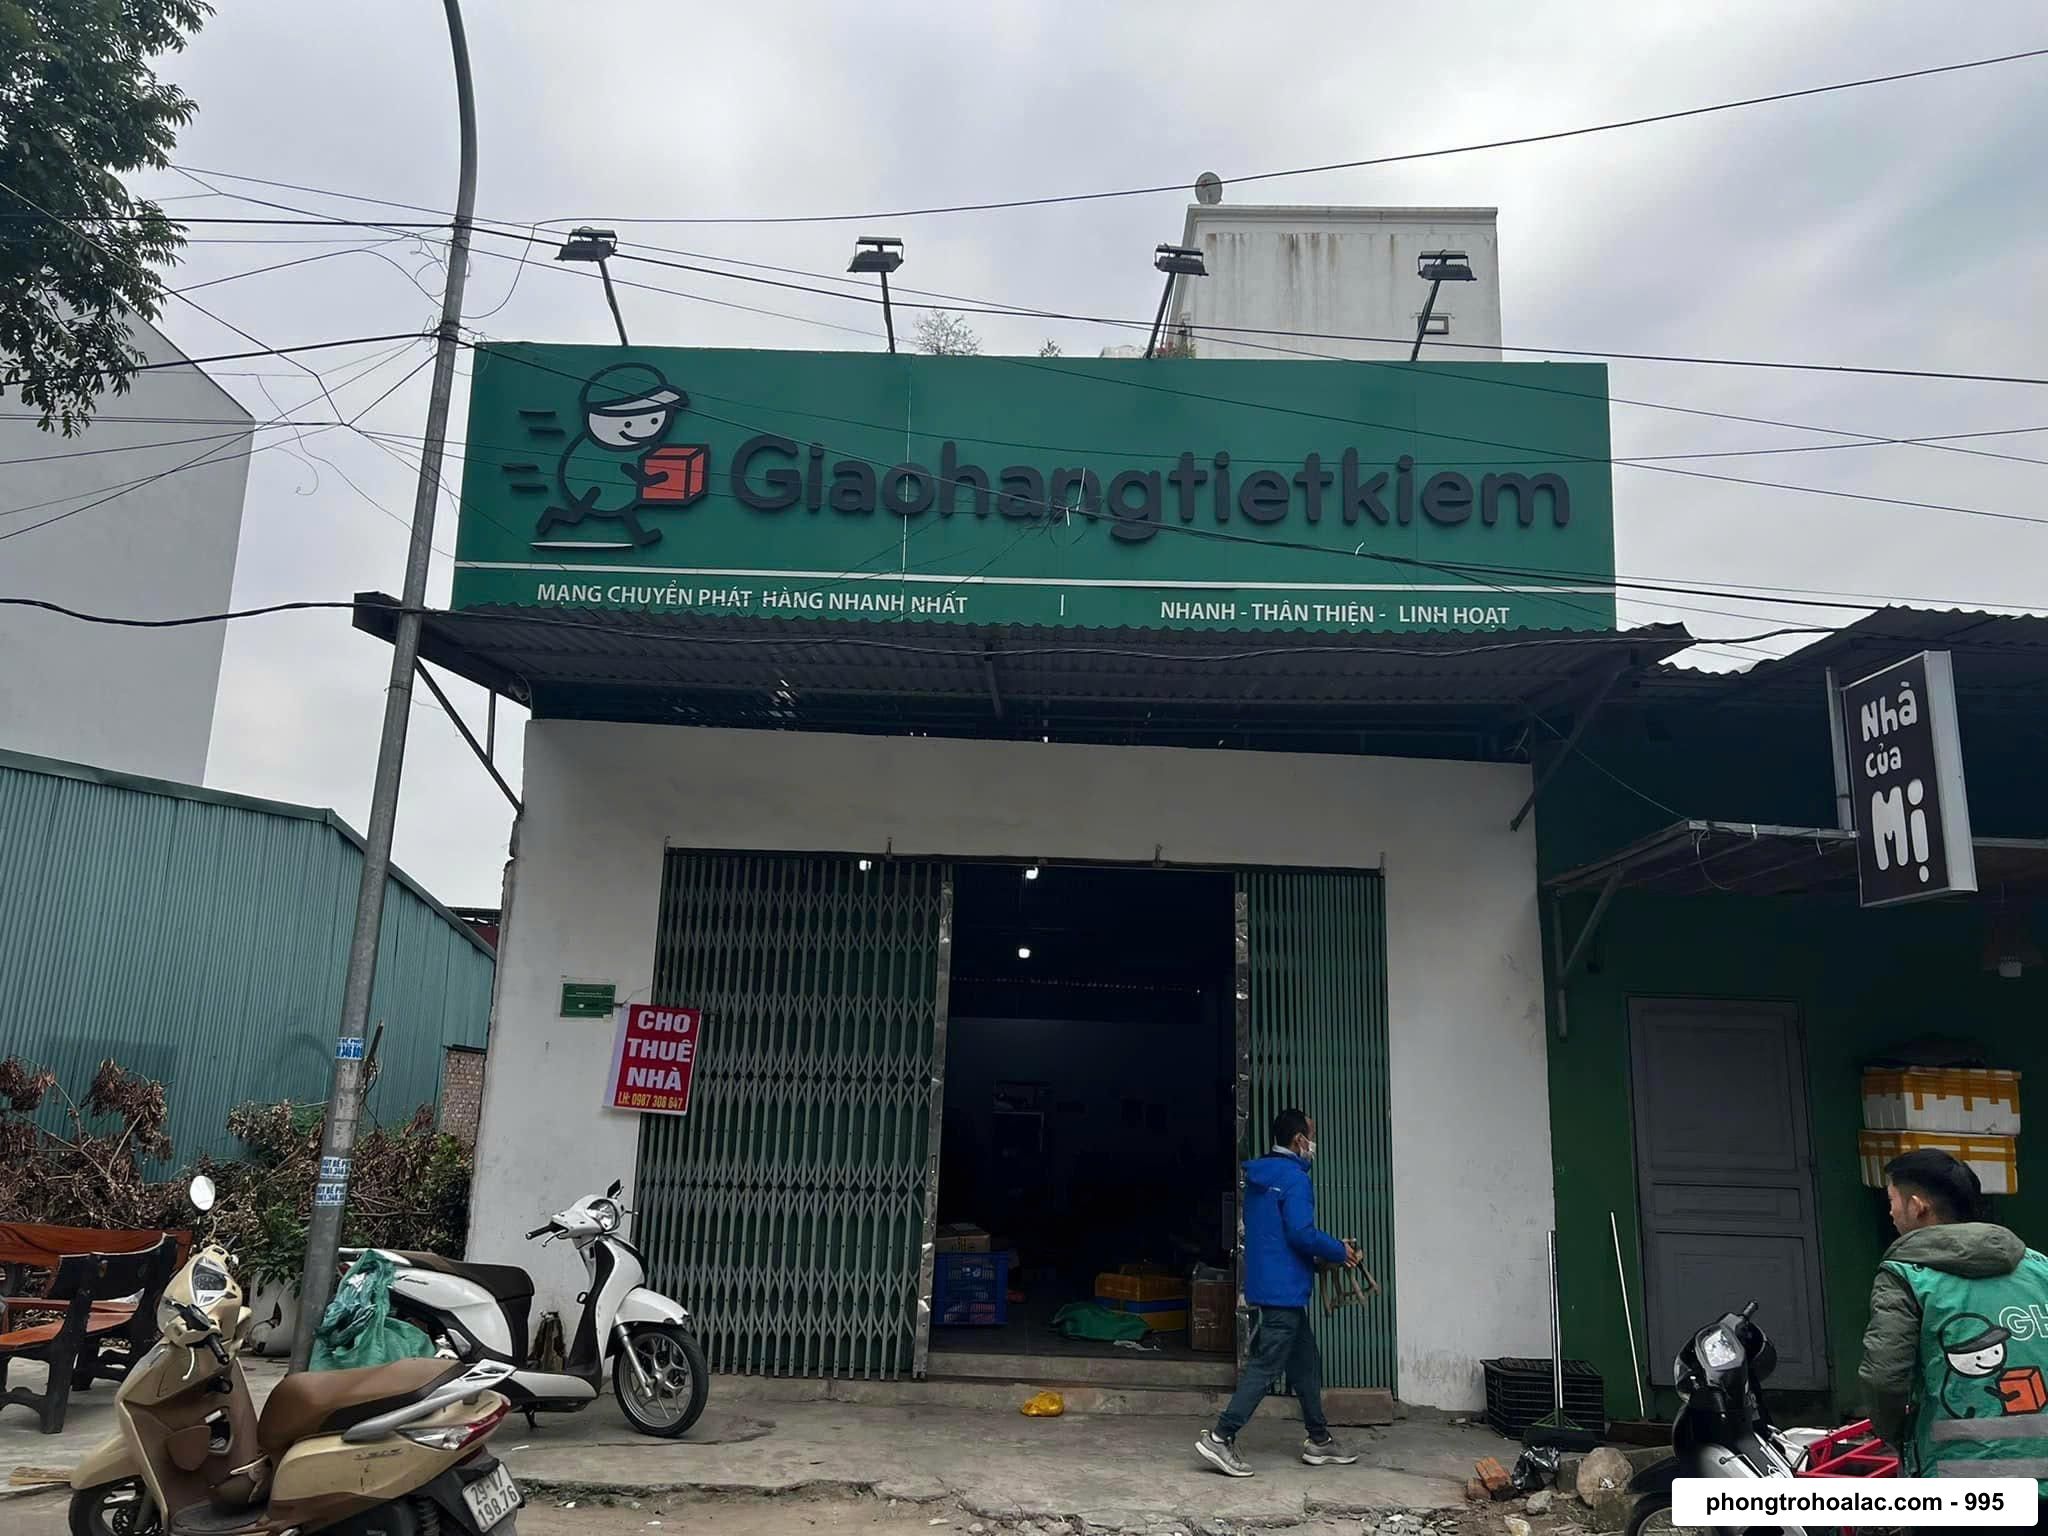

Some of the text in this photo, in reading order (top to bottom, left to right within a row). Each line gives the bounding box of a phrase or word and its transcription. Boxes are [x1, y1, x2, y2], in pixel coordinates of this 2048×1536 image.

[731, 433, 1572, 544] Giaohangtietkiem
[537, 579, 968, 614] MẠNG CHUYỂN PHÁT HÀNG NHANH NHẤT
[1160, 601, 1235, 620] NHANH
[1251, 600, 1309, 622] THÂN
[1313, 601, 1374, 626] THIỆN
[1399, 606, 1448, 624] LINH
[1453, 607, 1510, 628] HOẠT
[1861, 681, 1918, 743] Nhà
[1865, 743, 1902, 778] của
[1872, 778, 1930, 883] Mị
[637, 1010, 691, 1034] CHO
[627, 1037, 693, 1063] THUÊ
[626, 1066, 682, 1091] NHÀ
[478, 1484, 518, 1527] 198.76
